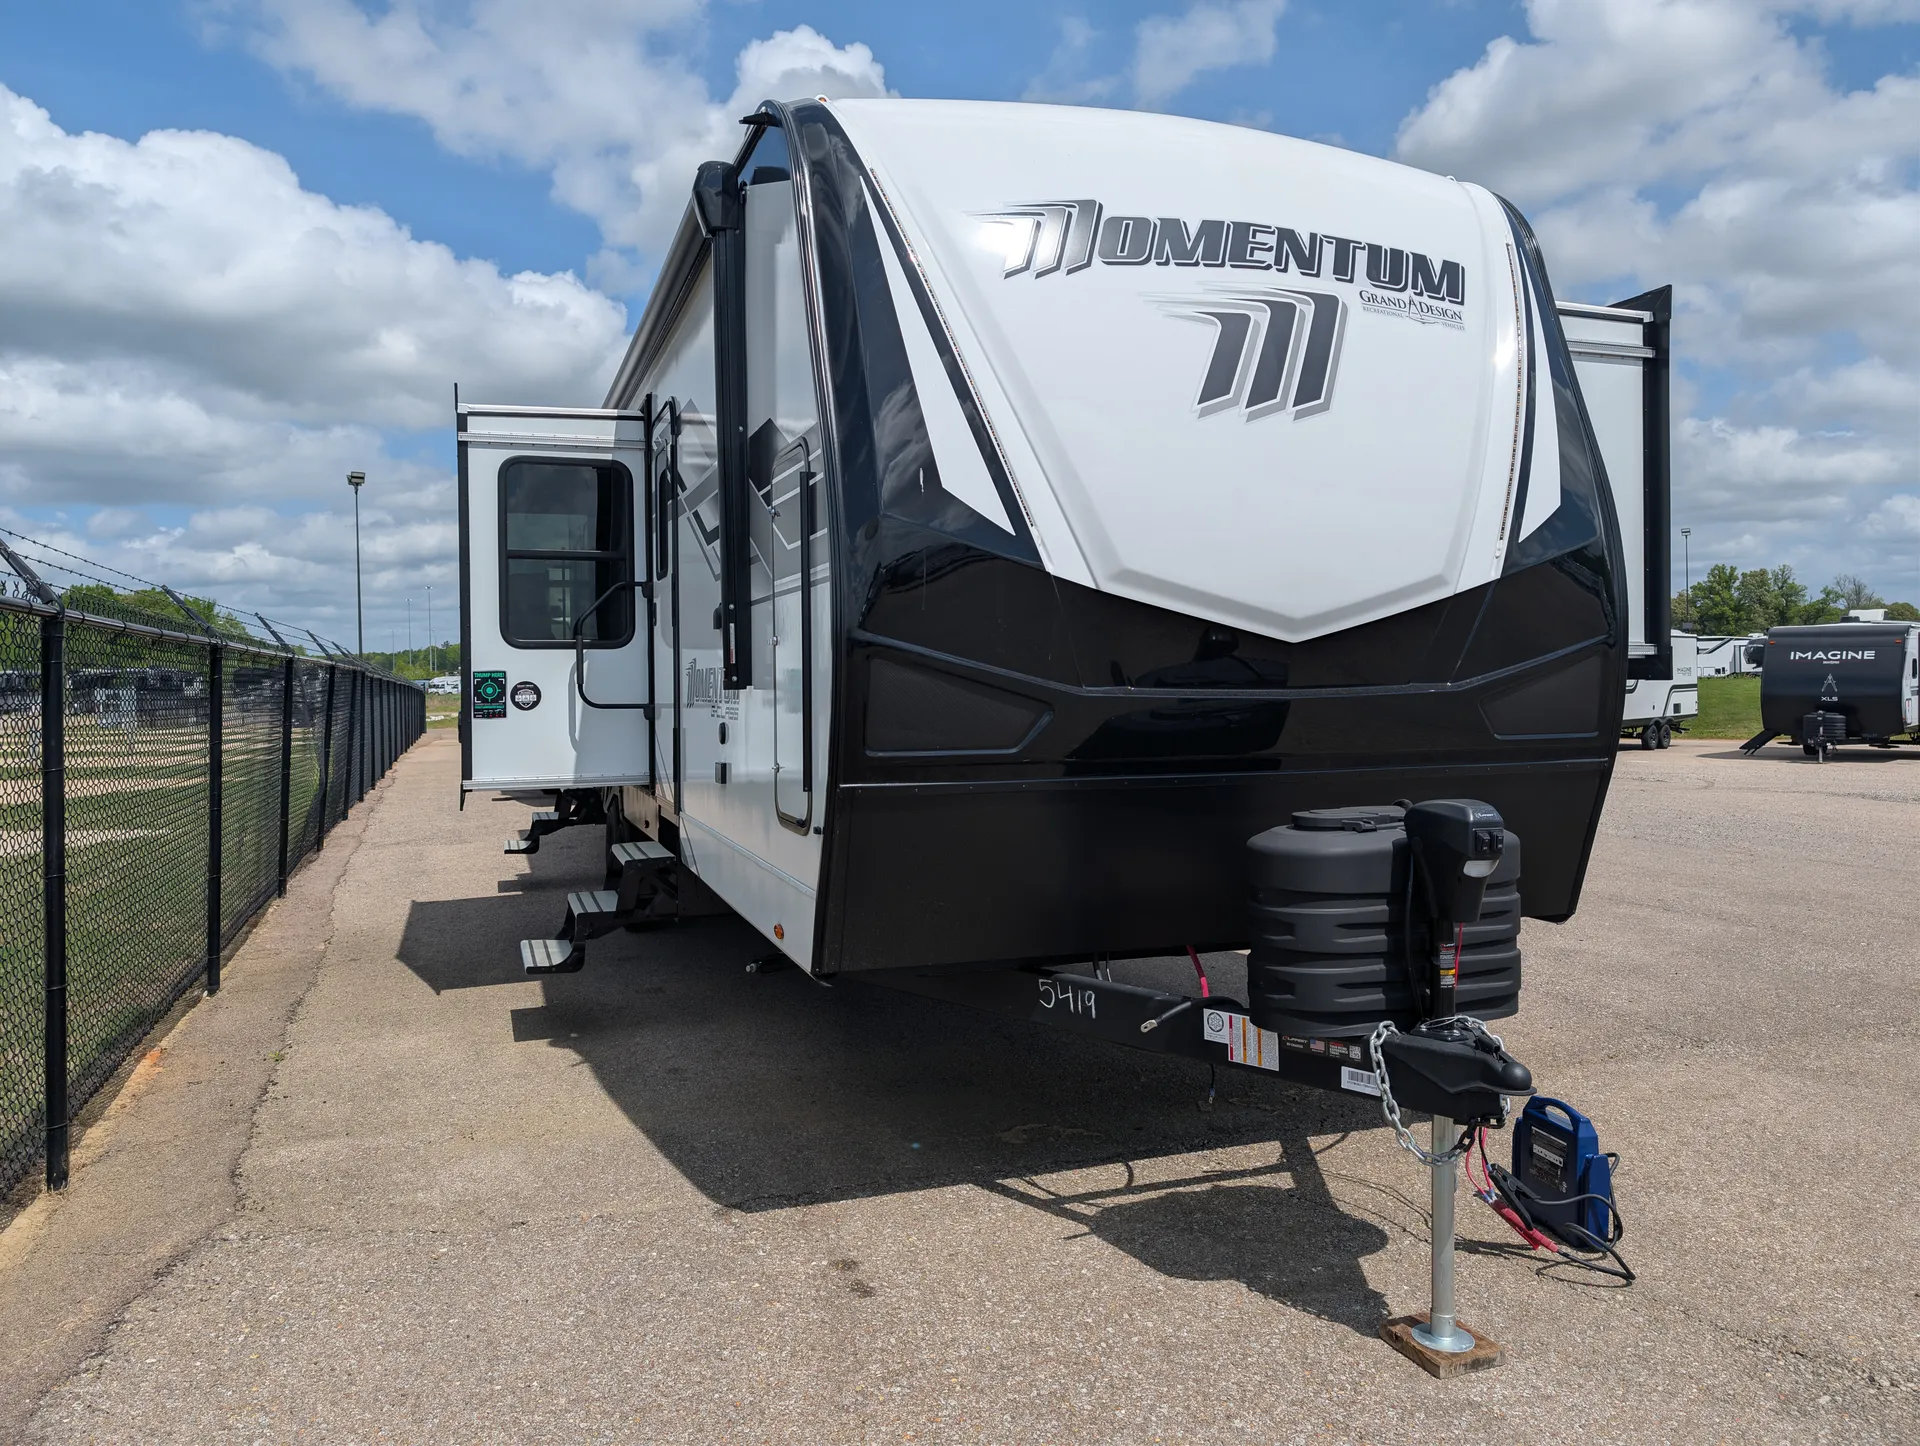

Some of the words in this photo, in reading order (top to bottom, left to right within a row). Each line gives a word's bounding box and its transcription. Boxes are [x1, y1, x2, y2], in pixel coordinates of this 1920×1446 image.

[965, 198, 1466, 306] MOMENTUM
[1359, 290, 1407, 310] GRAND
[1418, 301, 1463, 321] DESIGN
[1790, 650, 1876, 660] IMAGINE
[1038, 978, 1096, 1019] 5419
